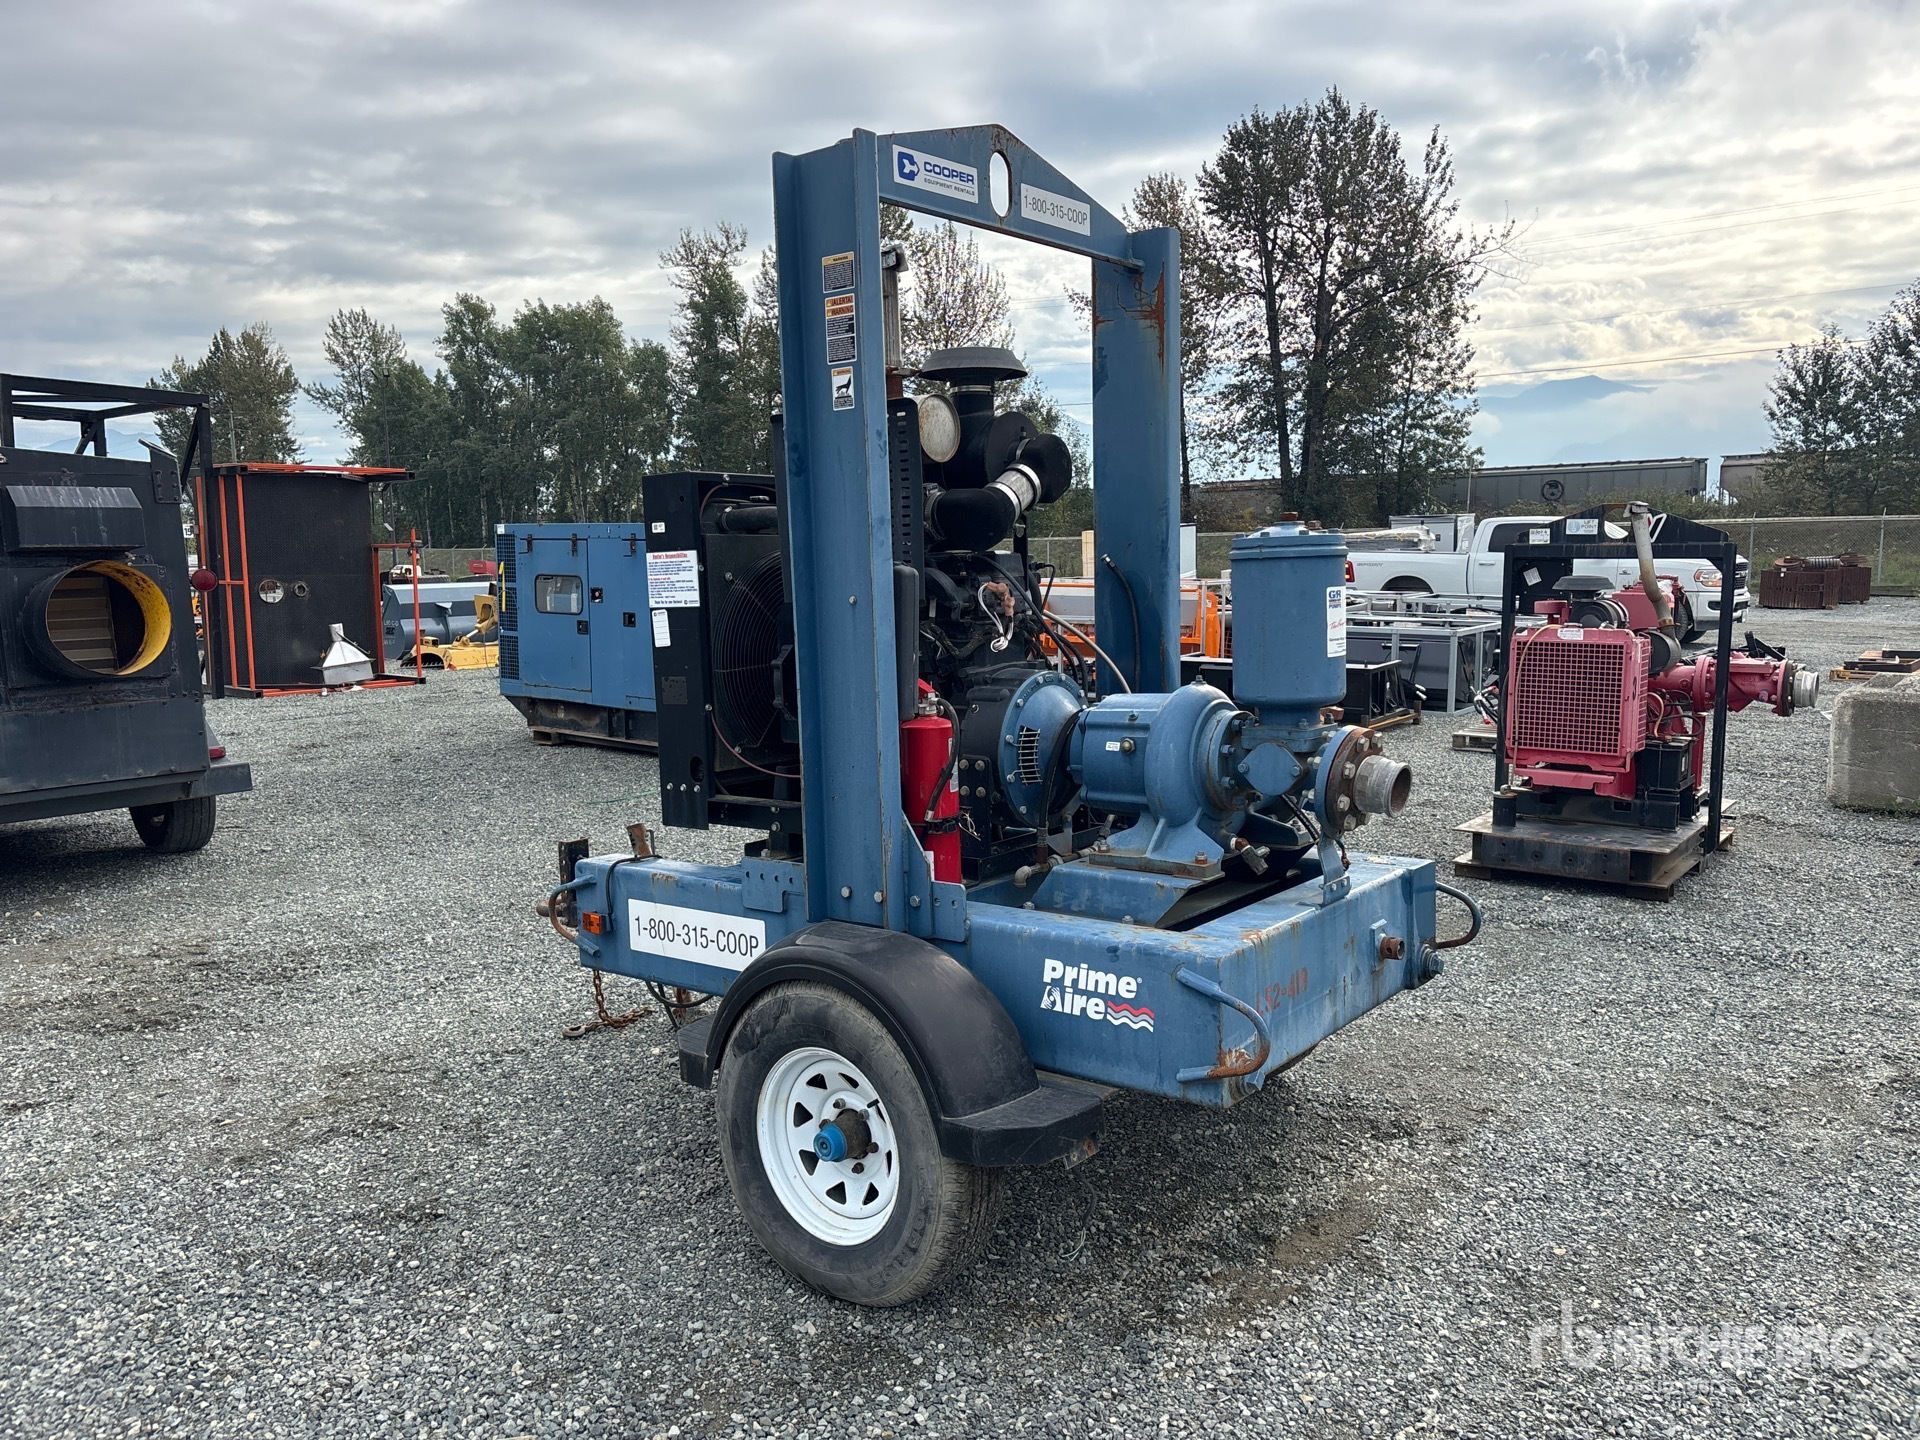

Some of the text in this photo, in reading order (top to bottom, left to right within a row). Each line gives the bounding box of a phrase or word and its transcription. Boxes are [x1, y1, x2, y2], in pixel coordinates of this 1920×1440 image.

[923, 161, 975, 185] COOPER
[924, 177, 975, 196] EQUIPMENT RENTALS
[1024, 195, 1088, 226] 1-800-315-COOP
[831, 304, 853, 316] WARNING
[634, 915, 759, 957] 1-800-315-COOP
[1042, 958, 1138, 999] Prime
[1040, 985, 1106, 1020] Aire
